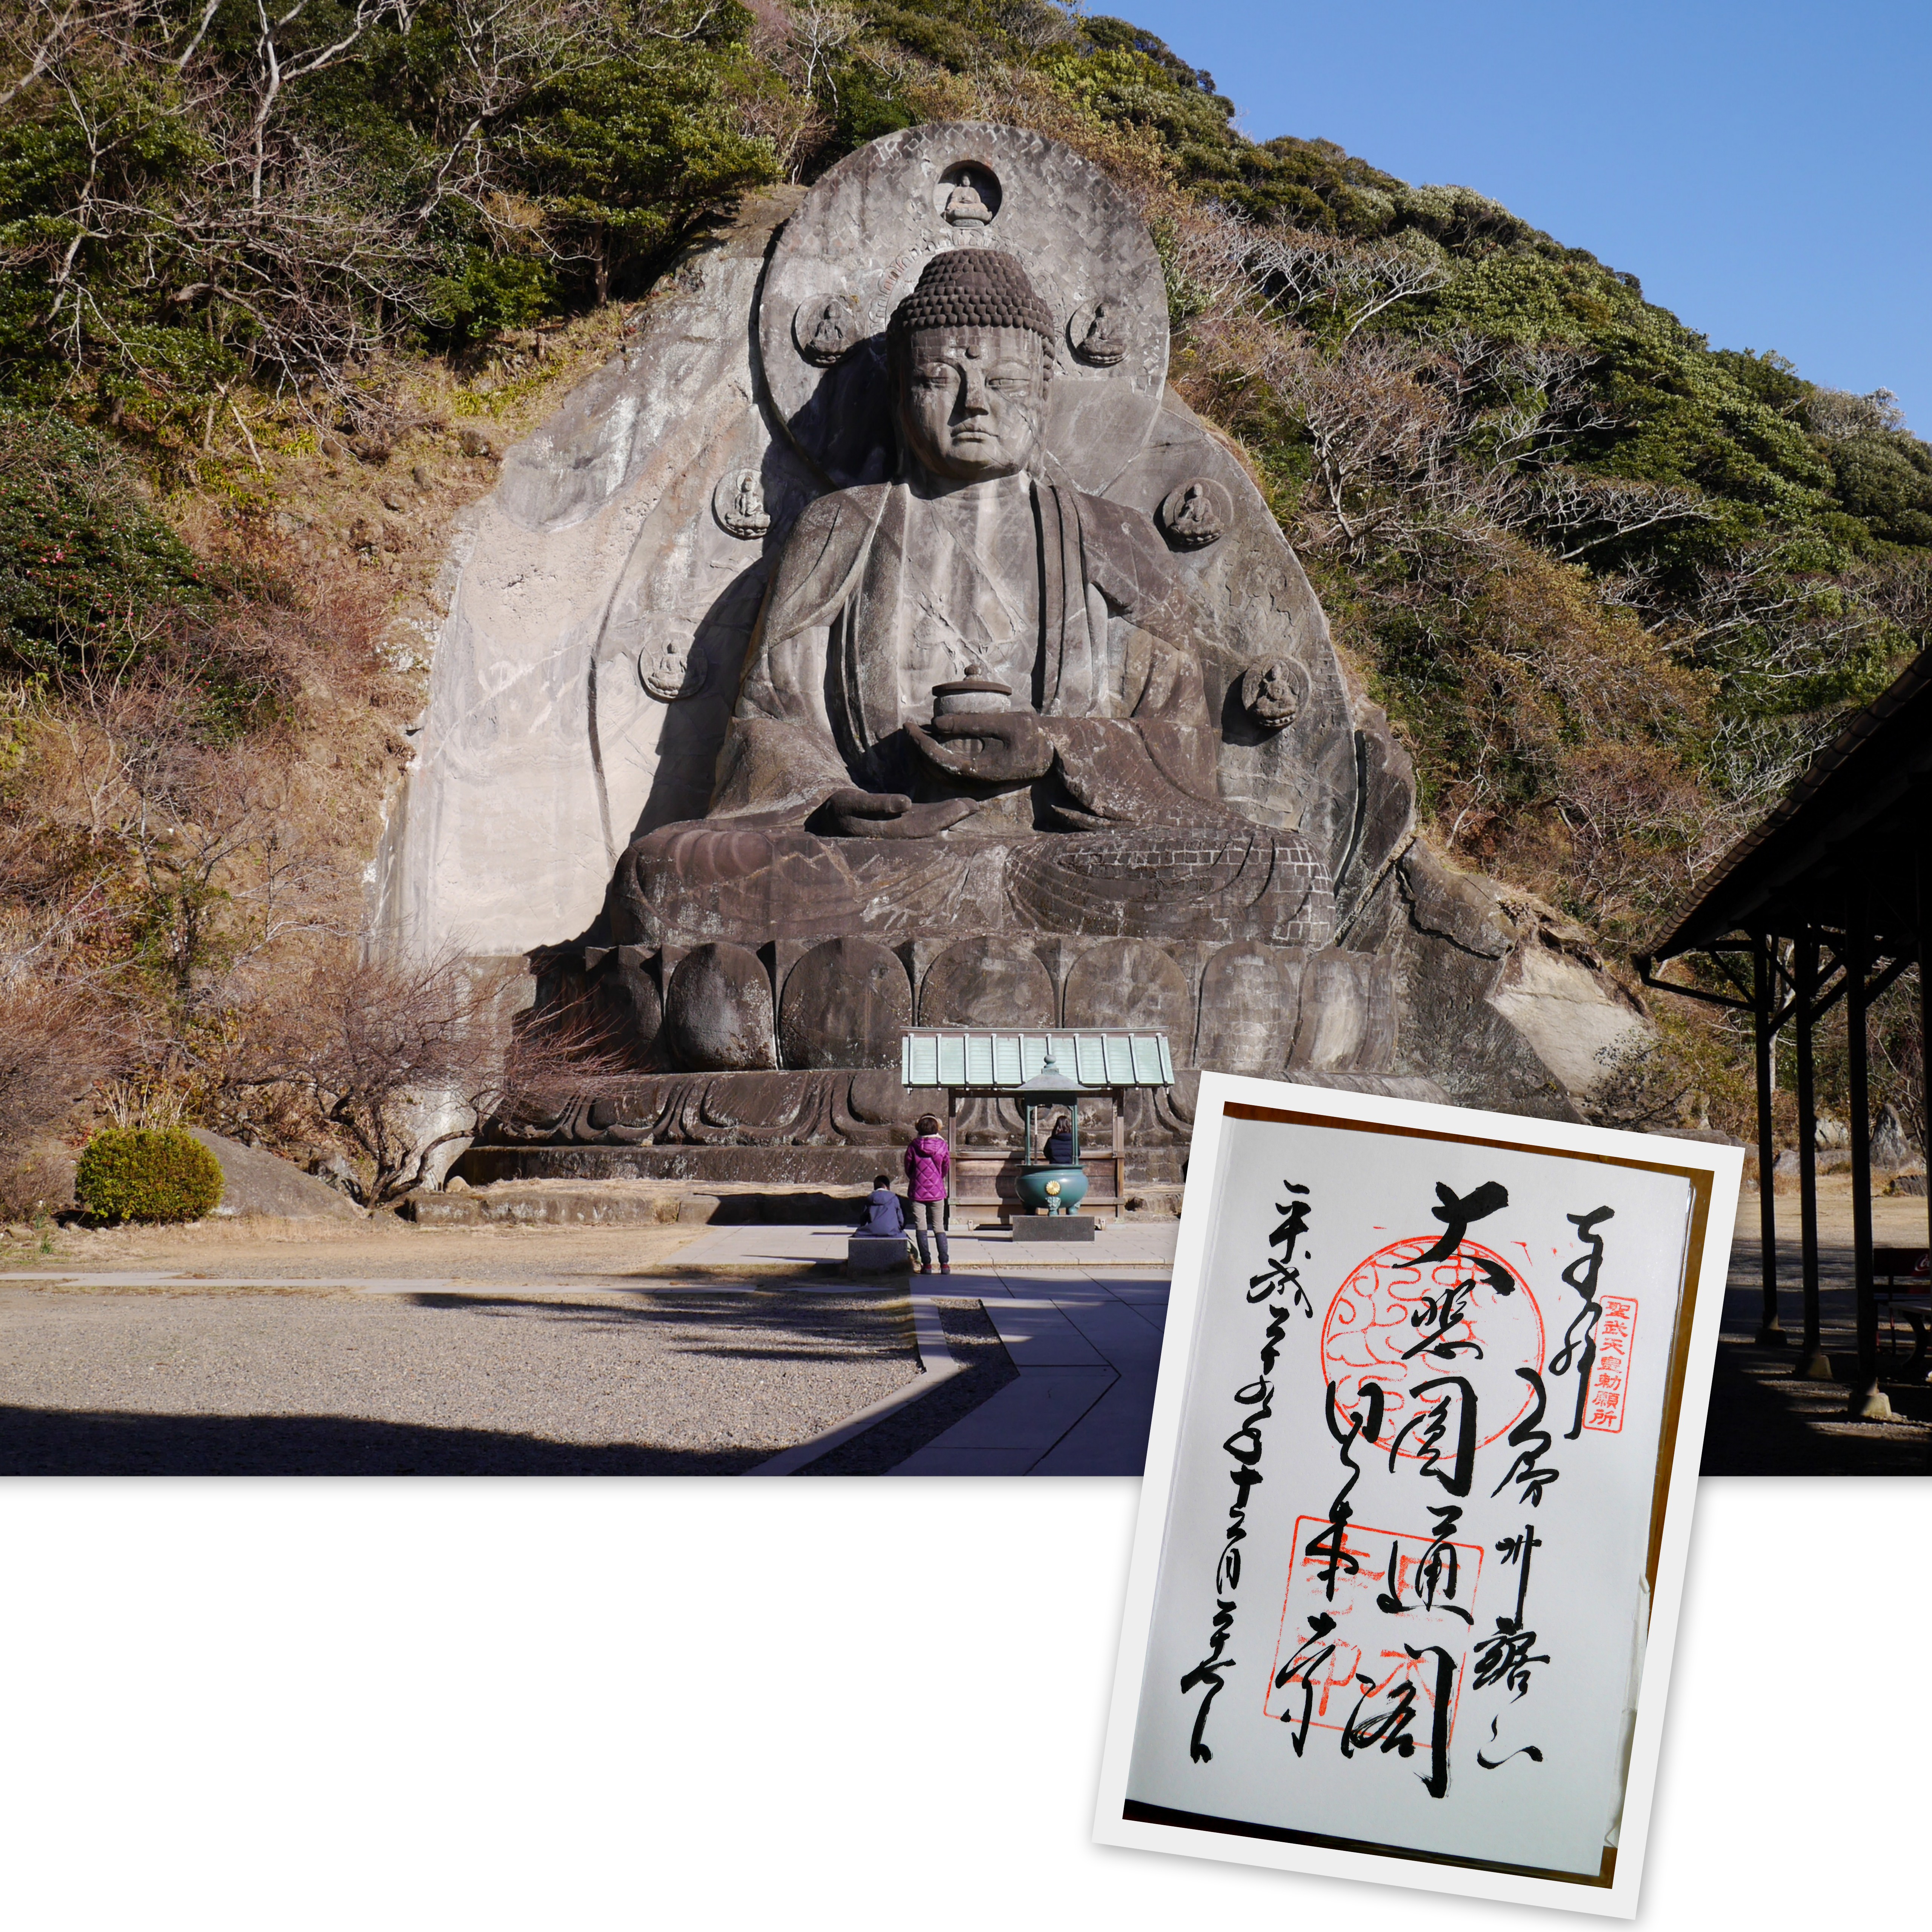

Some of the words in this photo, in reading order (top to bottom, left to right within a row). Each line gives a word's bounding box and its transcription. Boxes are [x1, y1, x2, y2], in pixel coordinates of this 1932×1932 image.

[1589, 1301, 1631, 1427] 聖武天皇勅願所
